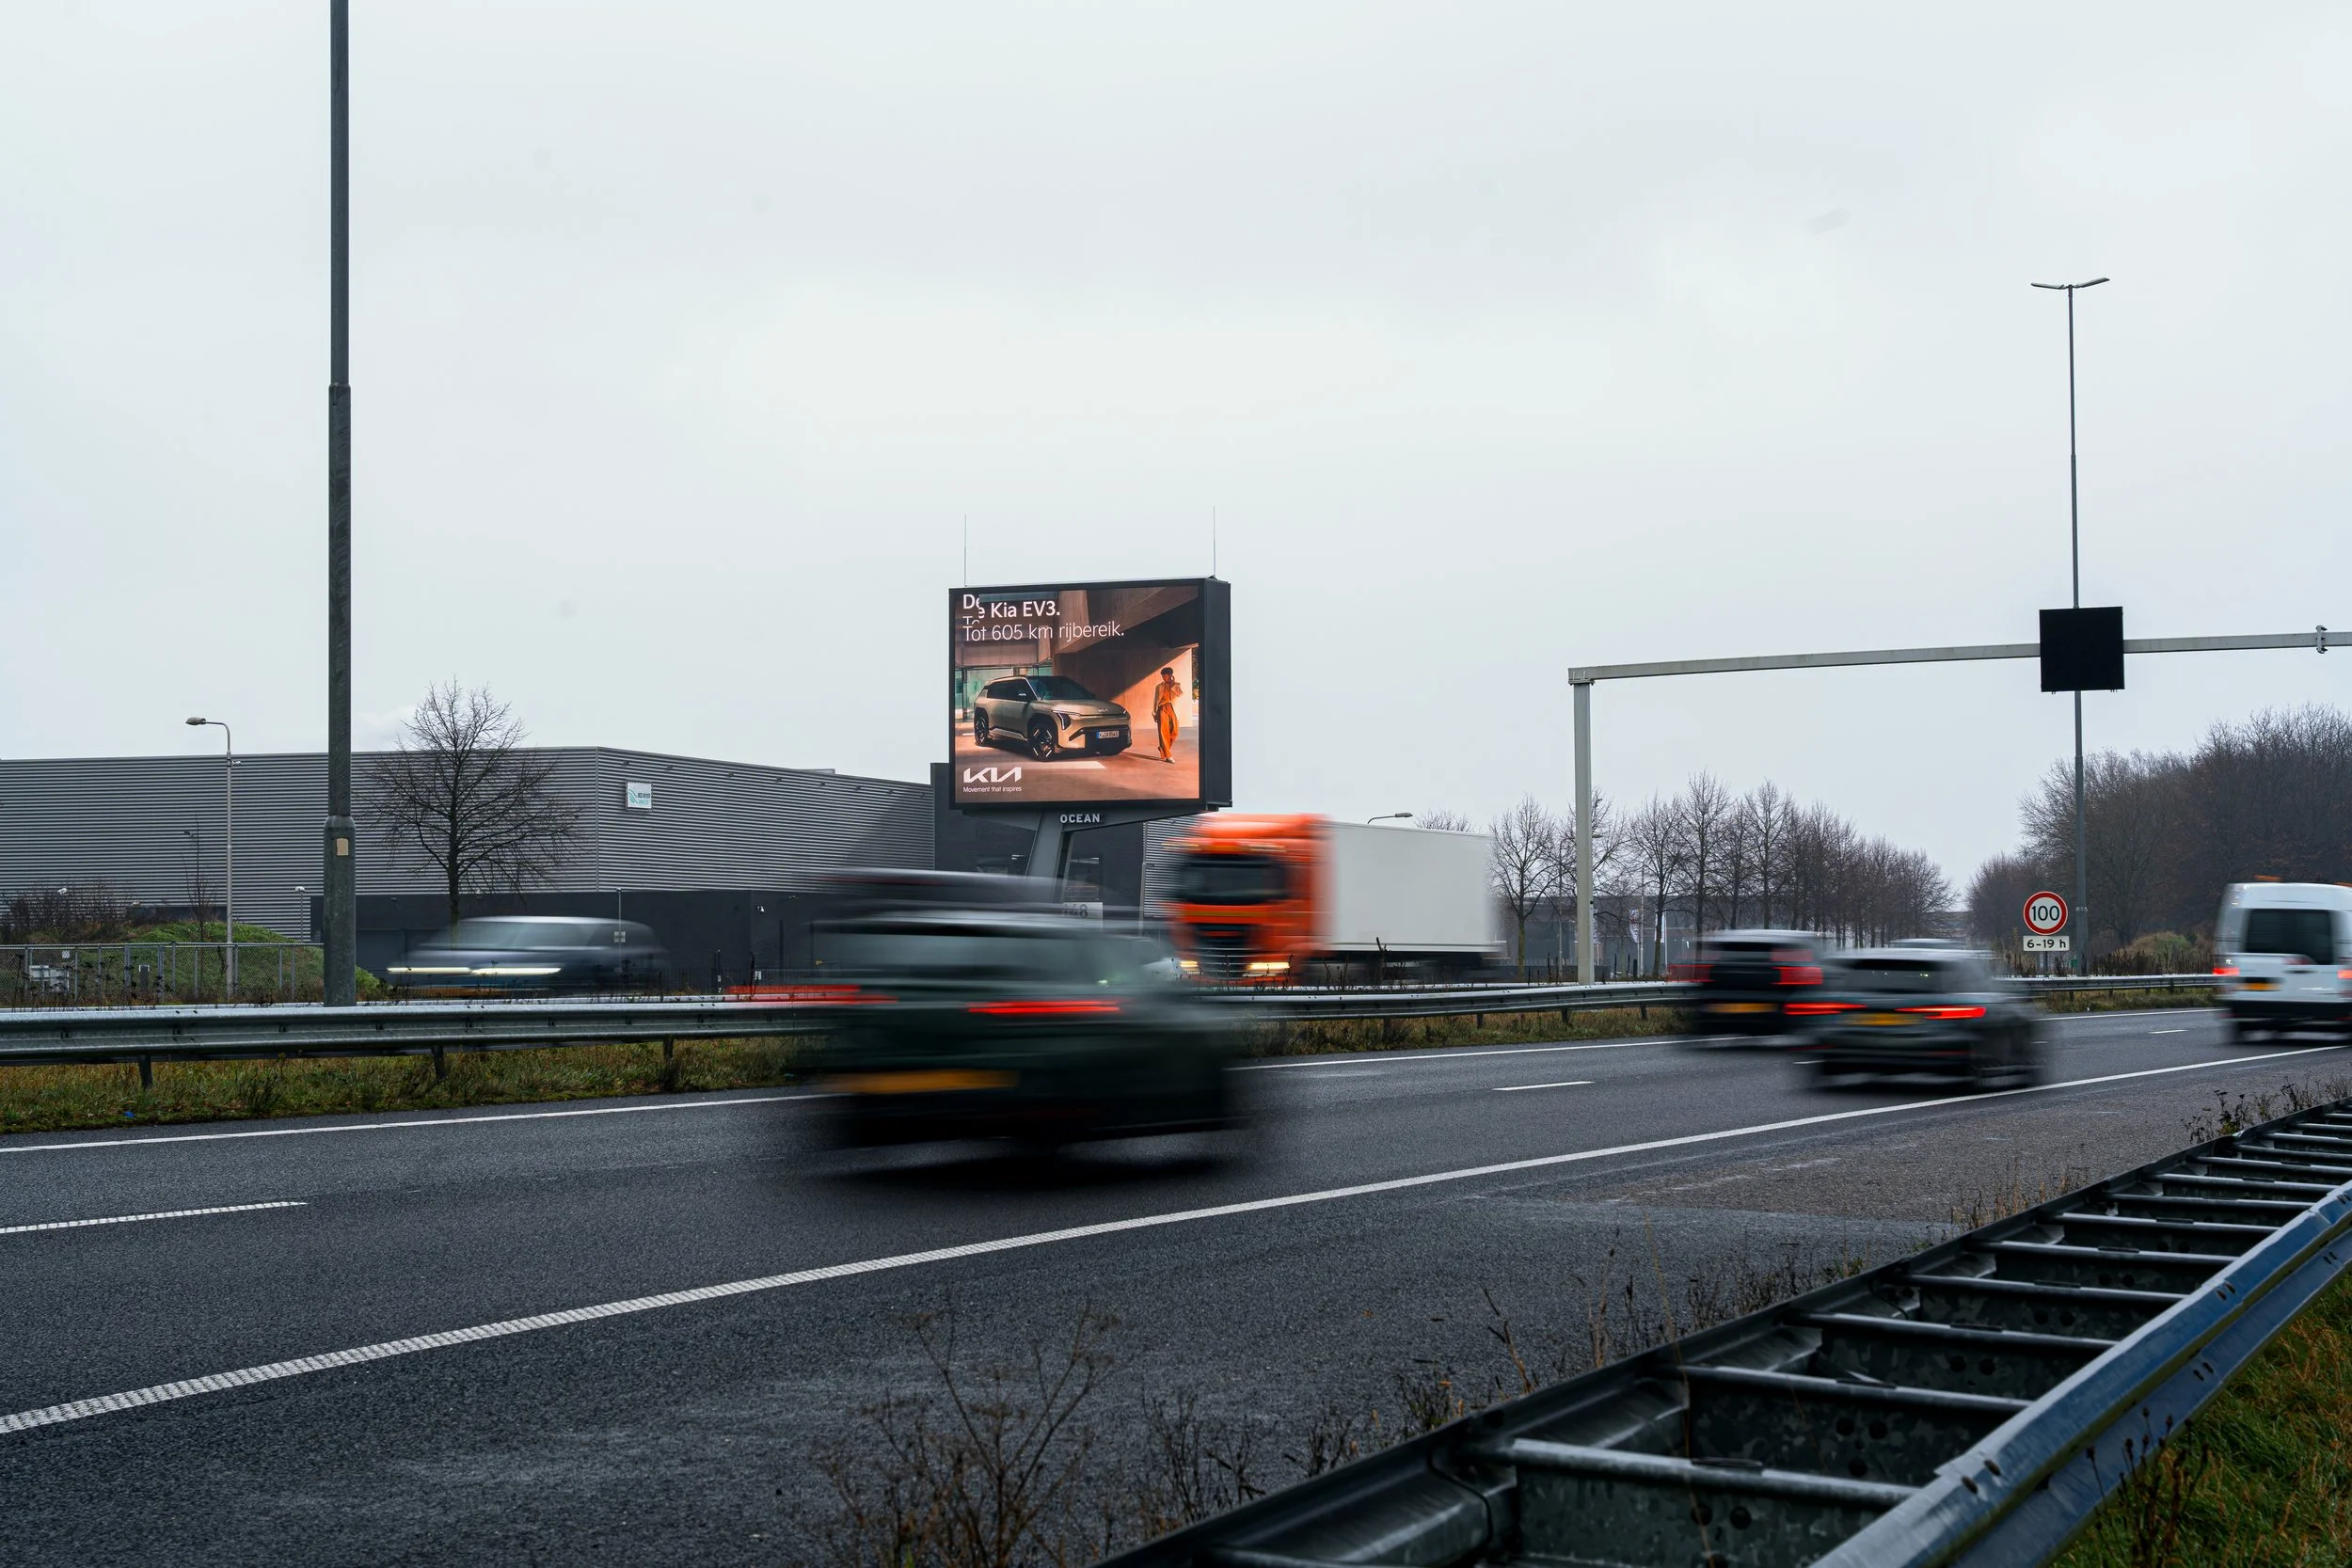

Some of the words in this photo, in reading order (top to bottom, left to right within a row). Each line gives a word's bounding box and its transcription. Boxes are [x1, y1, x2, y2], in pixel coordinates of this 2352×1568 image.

[991, 602, 1017, 618] Kia
[1023, 600, 1060, 617] EV3.
[962, 626, 987, 641] Tot
[992, 624, 1023, 641] 605
[1029, 624, 1053, 640] km
[1059, 621, 1124, 641] rijbereik.
[963, 767, 1022, 783] KIA
[1059, 814, 1100, 823] OCEAN
[2031, 905, 2060, 921] 100
[2026, 939, 2055, 948] 6-19
[2059, 939, 2066, 948] h
